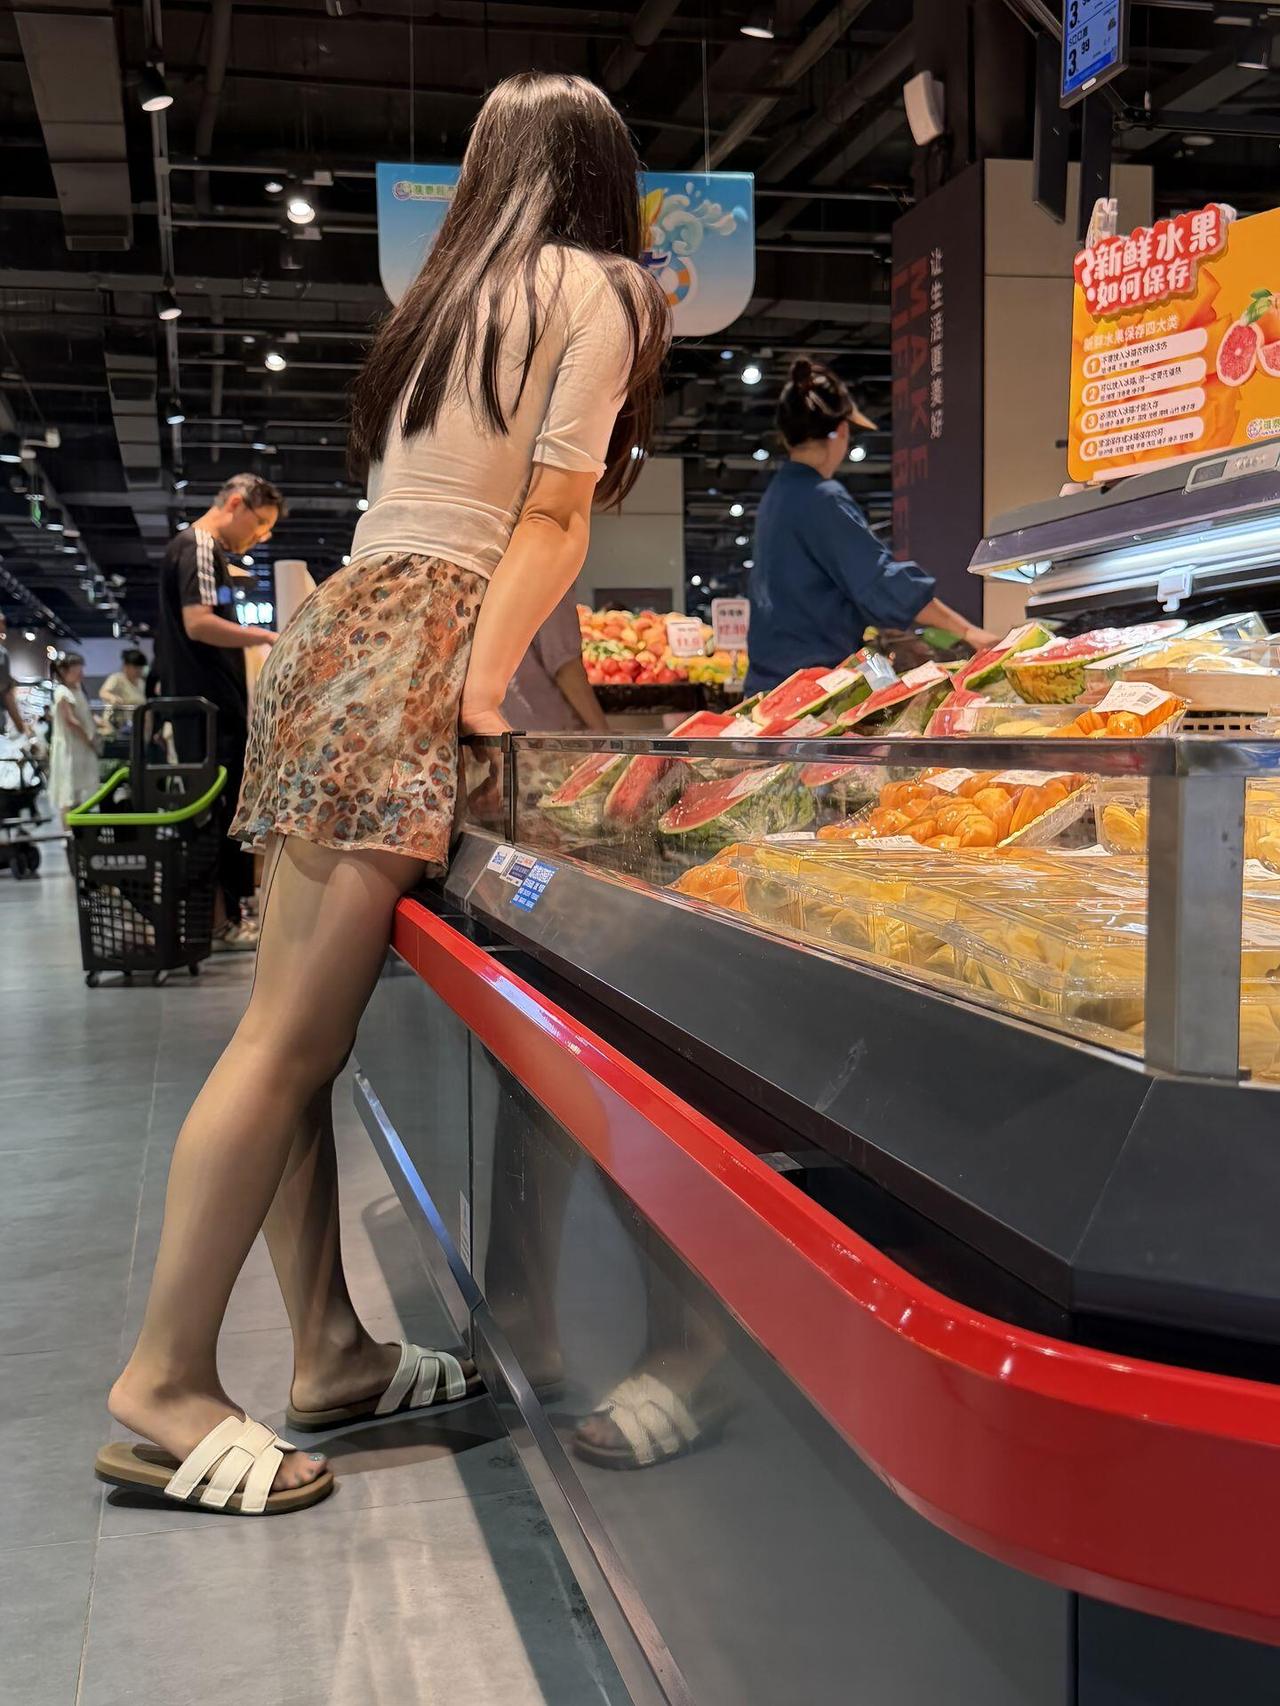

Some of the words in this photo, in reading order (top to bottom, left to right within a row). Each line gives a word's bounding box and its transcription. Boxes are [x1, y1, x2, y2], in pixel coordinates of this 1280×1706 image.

[1094, 210, 1216, 280] 新鲜水果
[1096, 257, 1189, 310] 如何保存
